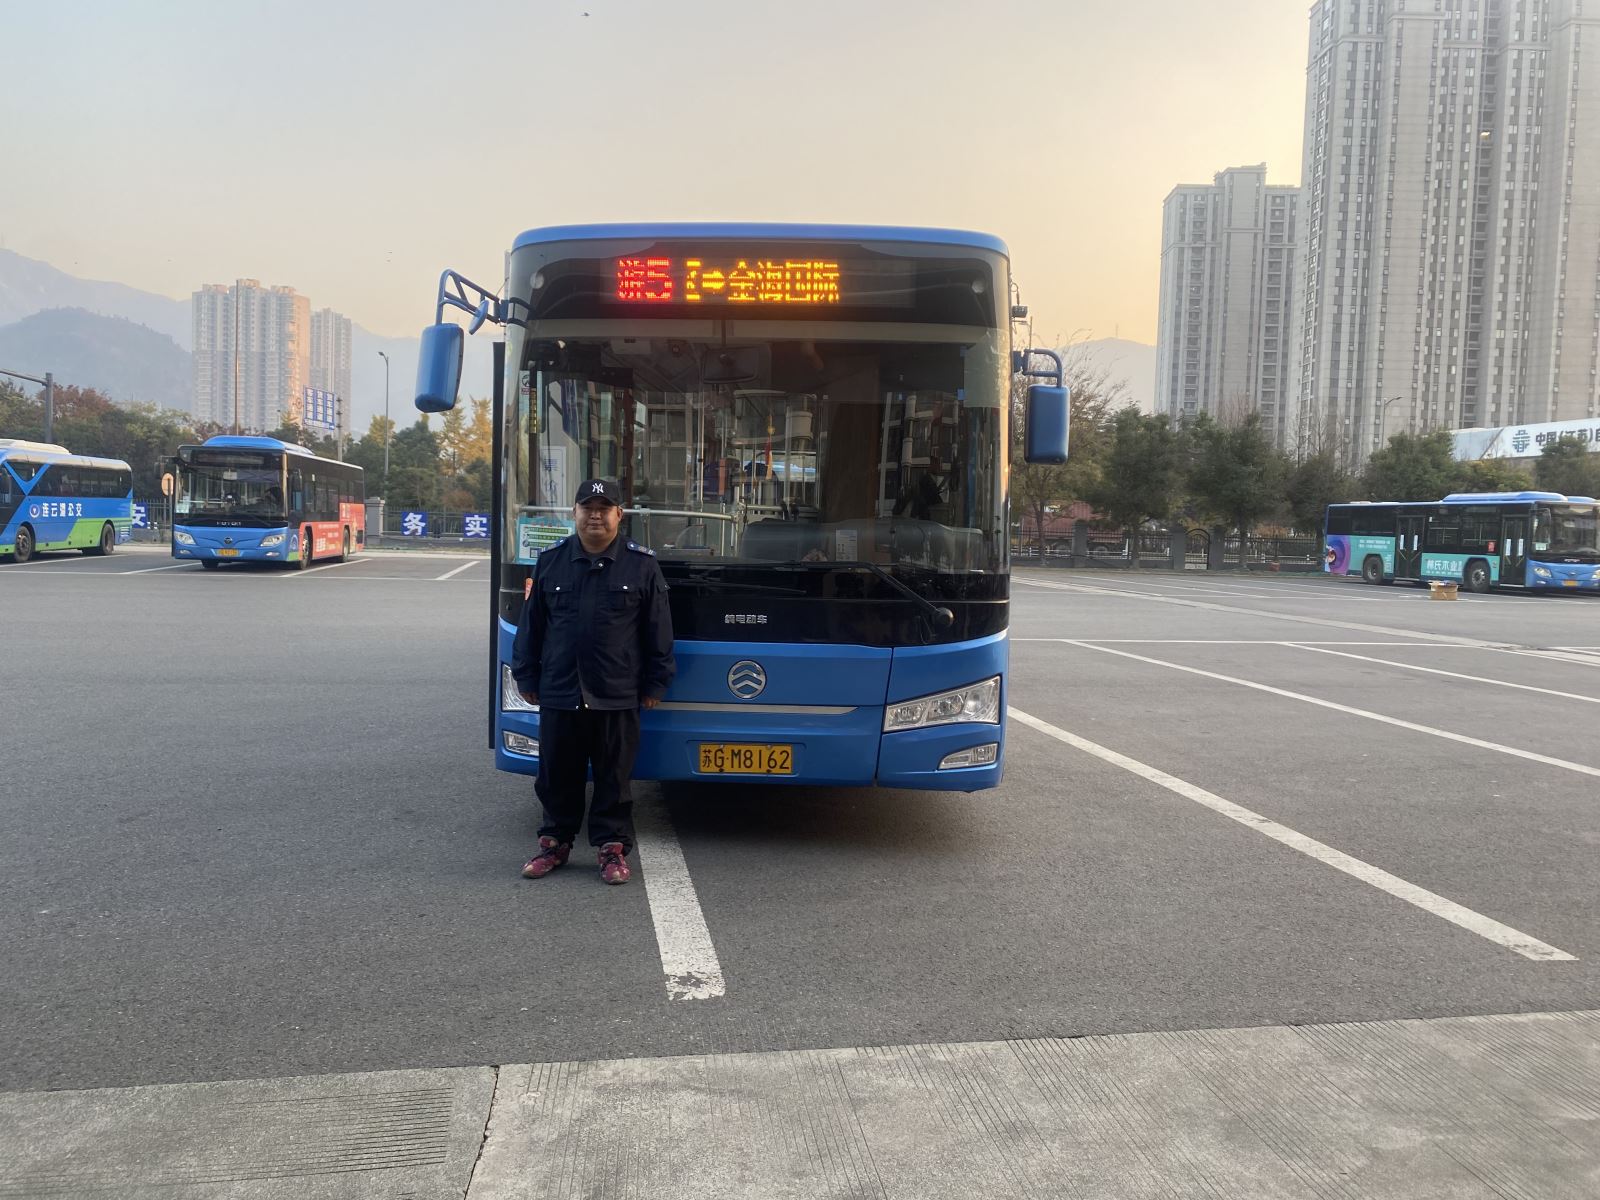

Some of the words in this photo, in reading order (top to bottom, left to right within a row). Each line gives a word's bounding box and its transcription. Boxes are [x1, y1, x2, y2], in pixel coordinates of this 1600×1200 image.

[592, 482, 604, 493] NY
[403, 512, 426, 536] 务
[465, 514, 488, 537] 实
[724, 613, 768, 625] 纯电动车
